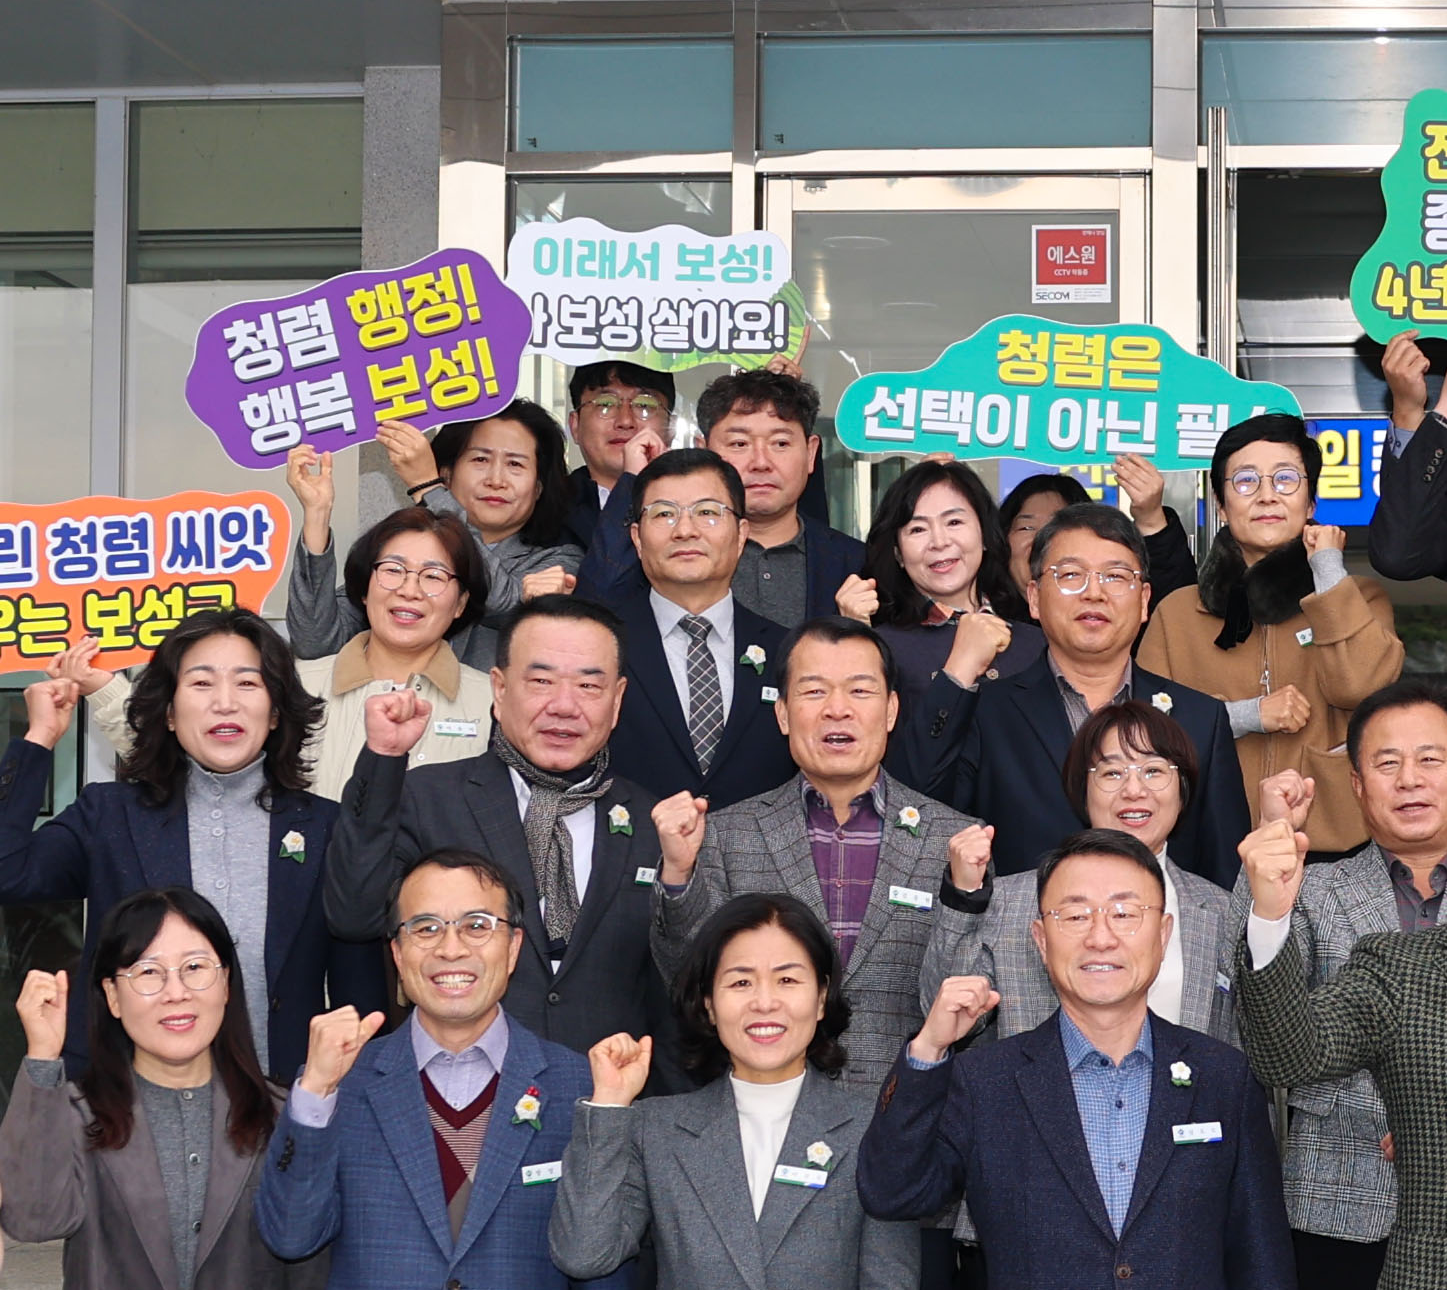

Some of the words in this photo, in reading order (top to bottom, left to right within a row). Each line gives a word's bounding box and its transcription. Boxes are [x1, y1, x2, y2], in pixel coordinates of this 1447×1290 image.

[533, 237, 660, 281] 이래서
[674, 242, 774, 284] 보성!
[1047, 245, 1095, 265] 에스원
[224, 299, 341, 382] 청렴
[348, 262, 485, 351] 행정!
[556, 293, 641, 353] 보성
[649, 297, 790, 354] 살아요!
[997, 329, 1162, 392] 청렴은
[239, 371, 357, 455] 행복
[368, 337, 500, 422] 보성!
[864, 386, 1030, 450] 선택이
[1047, 398, 1158, 456] 아닌
[1176, 402, 1268, 459] 필
[47, 512, 155, 585] 청렴
[166, 505, 275, 574] 씨앗
